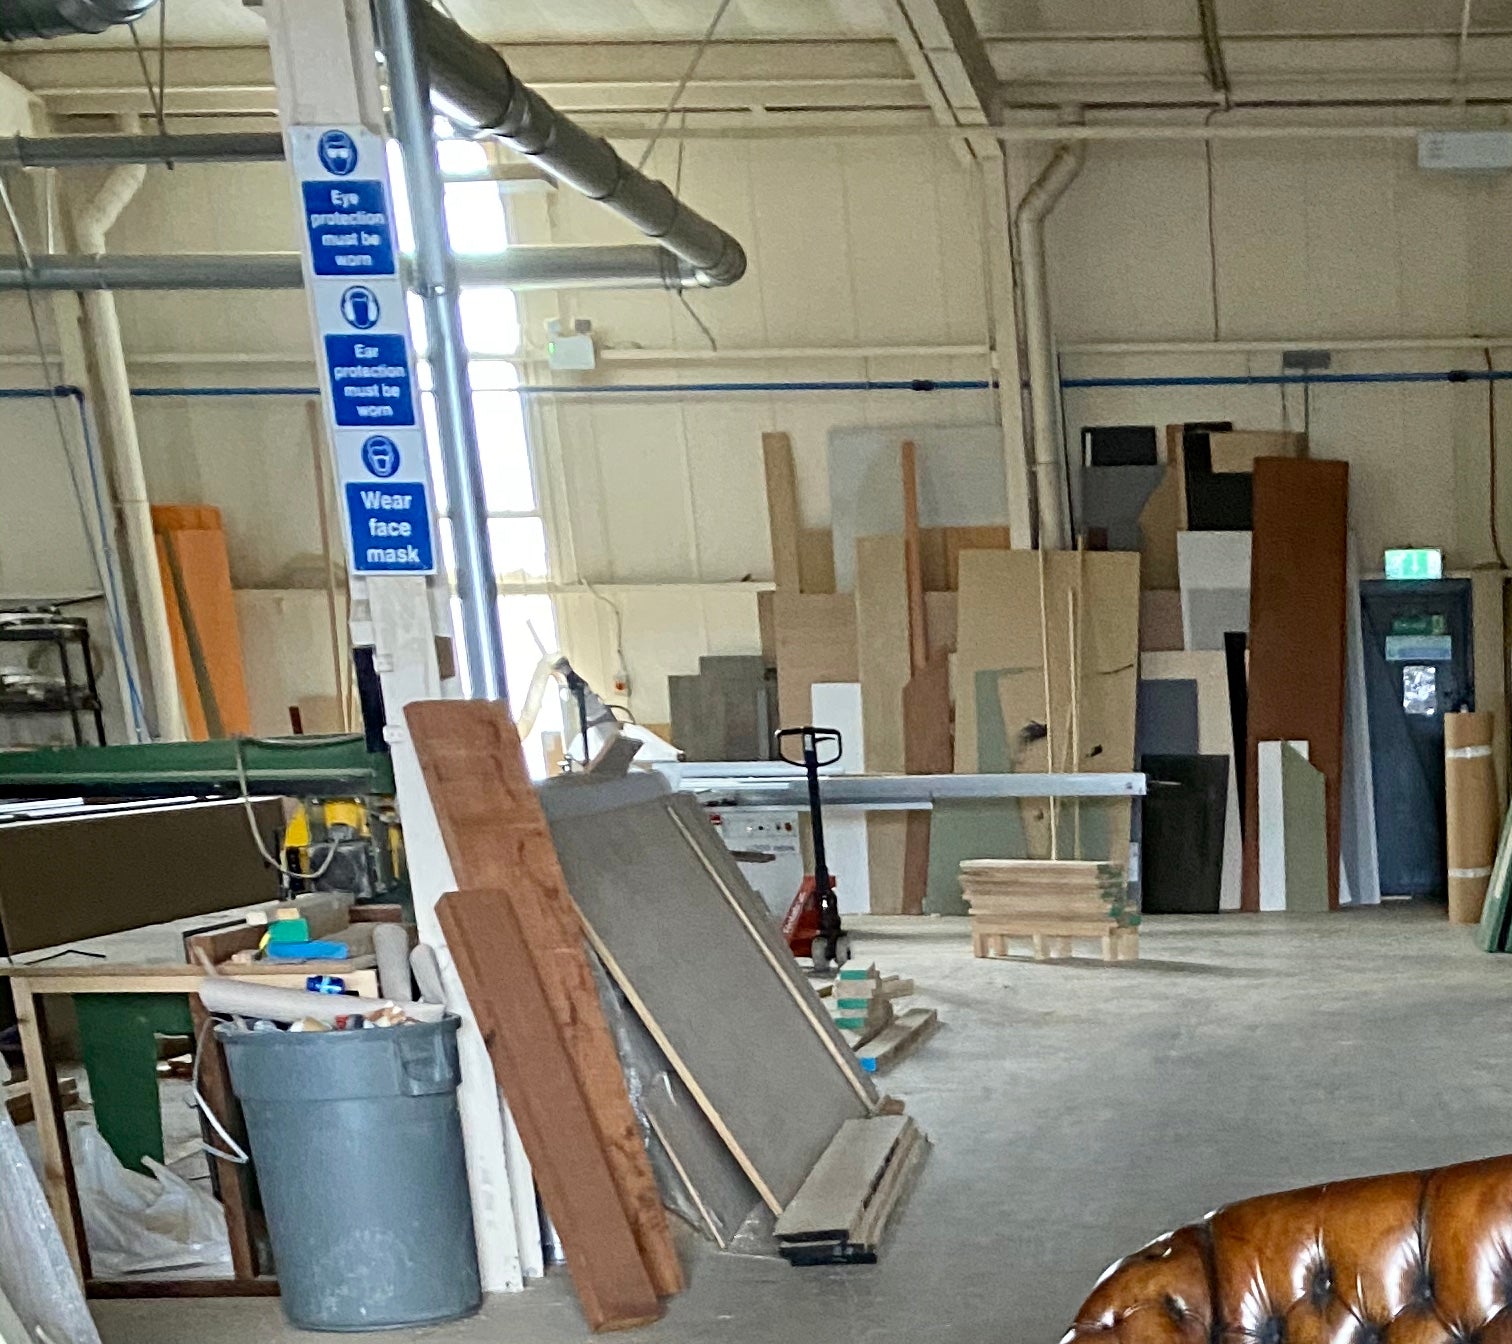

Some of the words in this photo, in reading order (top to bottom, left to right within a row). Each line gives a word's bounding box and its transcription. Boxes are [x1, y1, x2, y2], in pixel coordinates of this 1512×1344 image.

[330, 189, 360, 208] Eye
[311, 210, 385, 228] protection
[322, 232, 358, 246] must
[360, 231, 380, 246] be
[334, 254, 373, 266] worn
[354, 343, 379, 358] Ear
[334, 364, 406, 381] protection
[343, 384, 379, 397] must
[381, 383, 400, 398] be
[356, 405, 394, 417] worn
[360, 490, 412, 510] Wear
[368, 517, 412, 537] face
[366, 544, 420, 563] mask
